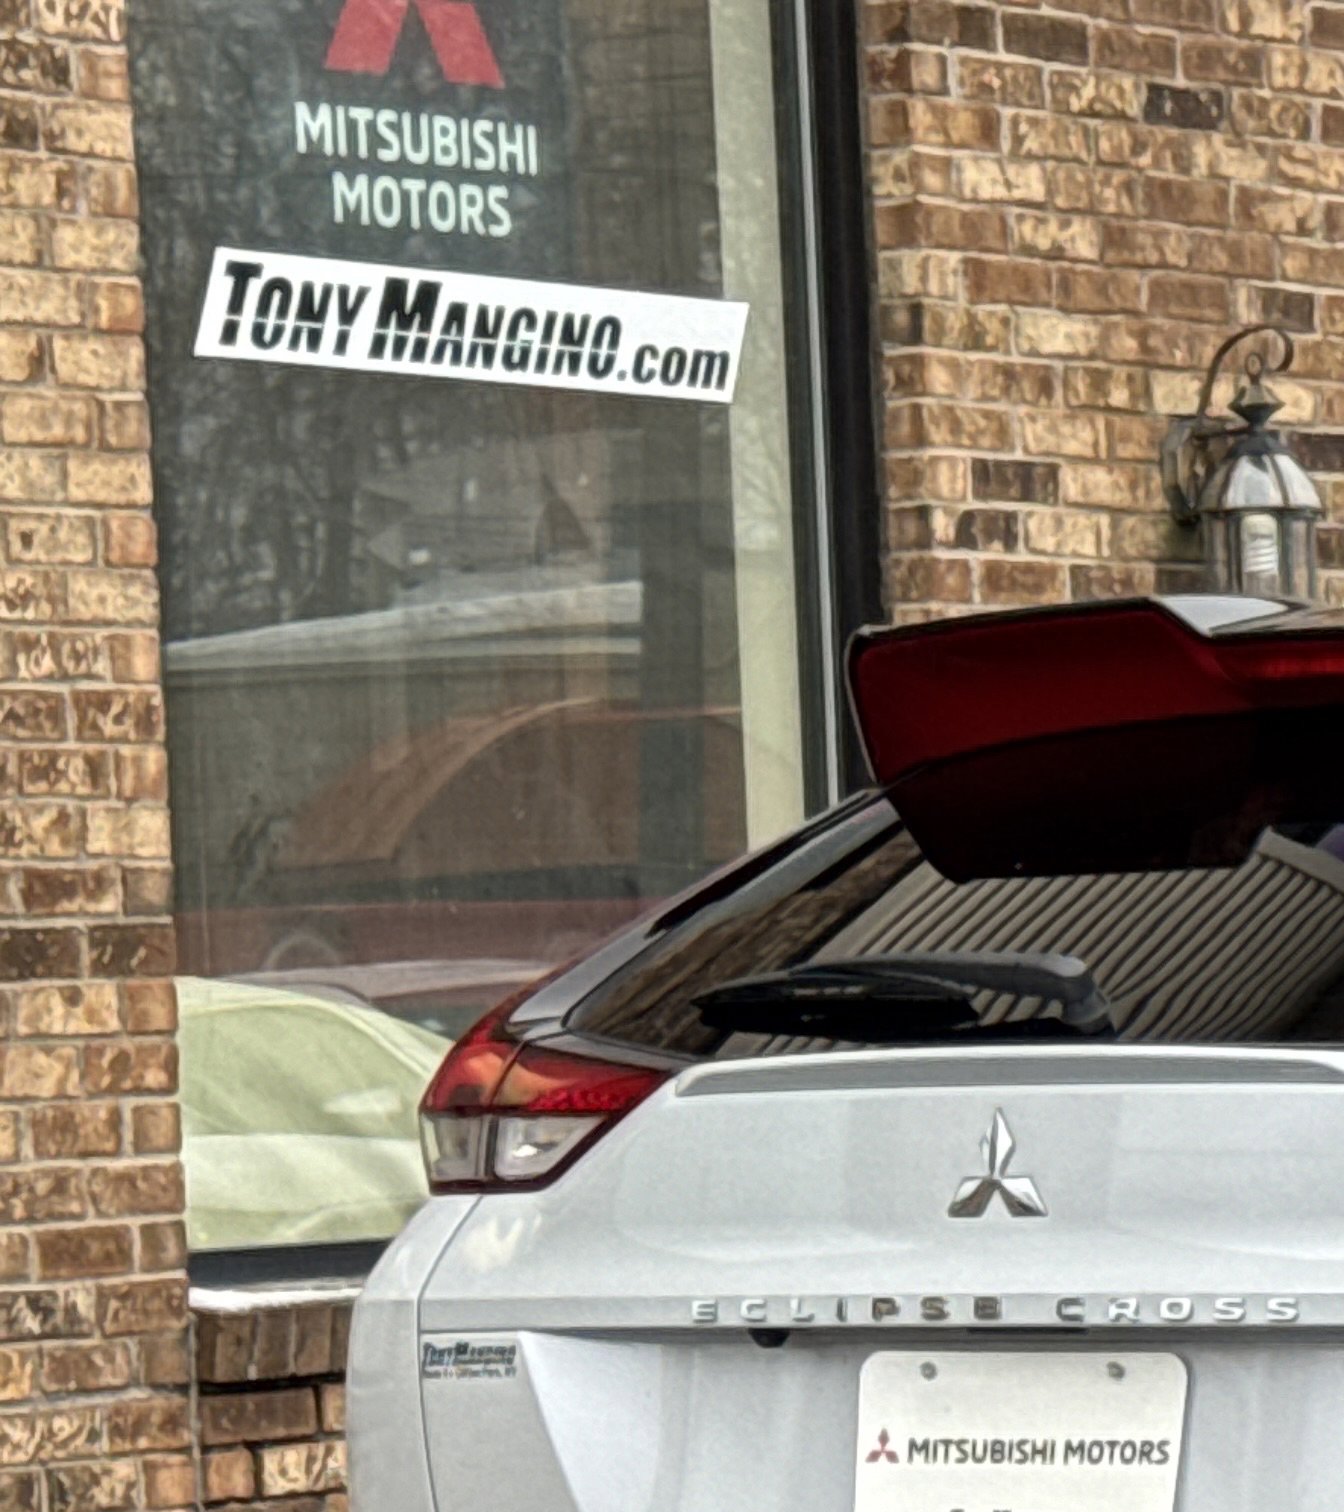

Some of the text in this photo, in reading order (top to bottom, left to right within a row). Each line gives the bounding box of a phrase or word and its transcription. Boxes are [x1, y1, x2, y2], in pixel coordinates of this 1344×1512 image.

[295, 101, 539, 176] MITSUBISHI
[332, 171, 514, 238] MOTORS
[690, 1296, 1301, 1323] ECLIPSE CROSS
[907, 1437, 1171, 1466] MITSUBISHI MOTORS
